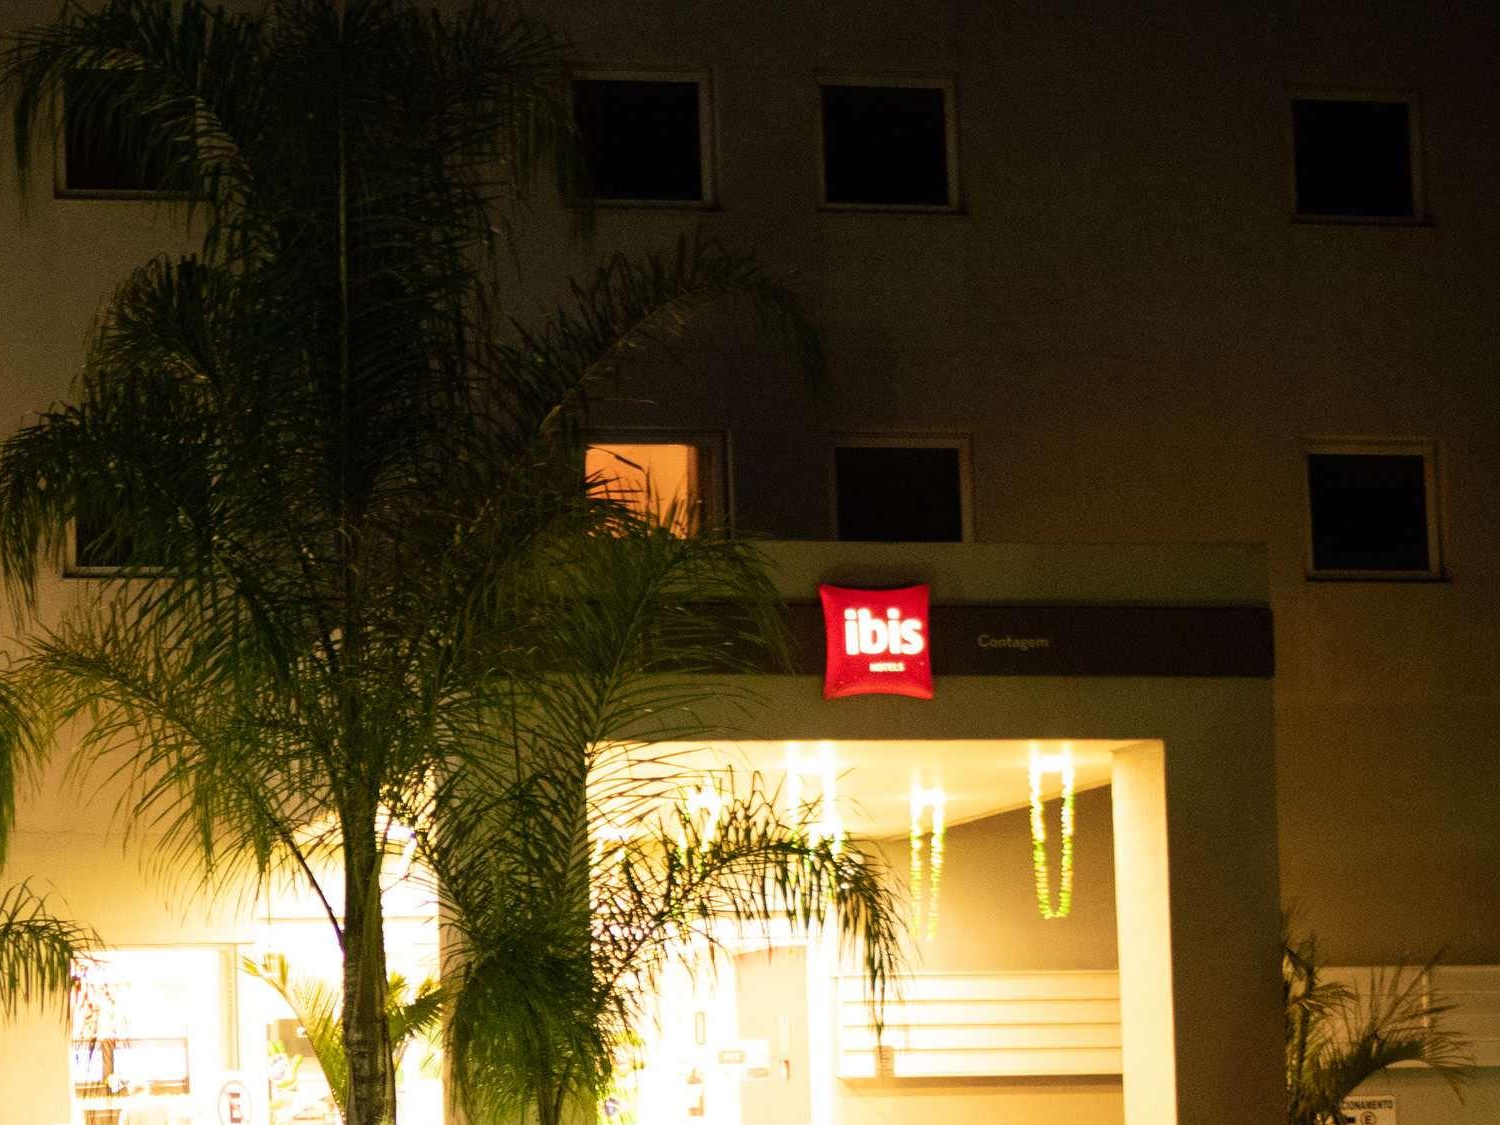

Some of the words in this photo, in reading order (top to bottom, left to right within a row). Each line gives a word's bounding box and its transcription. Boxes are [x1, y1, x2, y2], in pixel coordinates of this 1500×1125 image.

[844, 608, 925, 655] ibis
[979, 634, 1049, 652] Contagem
[228, 1092, 243, 1124] E
[1339, 1099, 1393, 1111] CIONAMENTO
[1364, 1114, 1372, 1125] E
